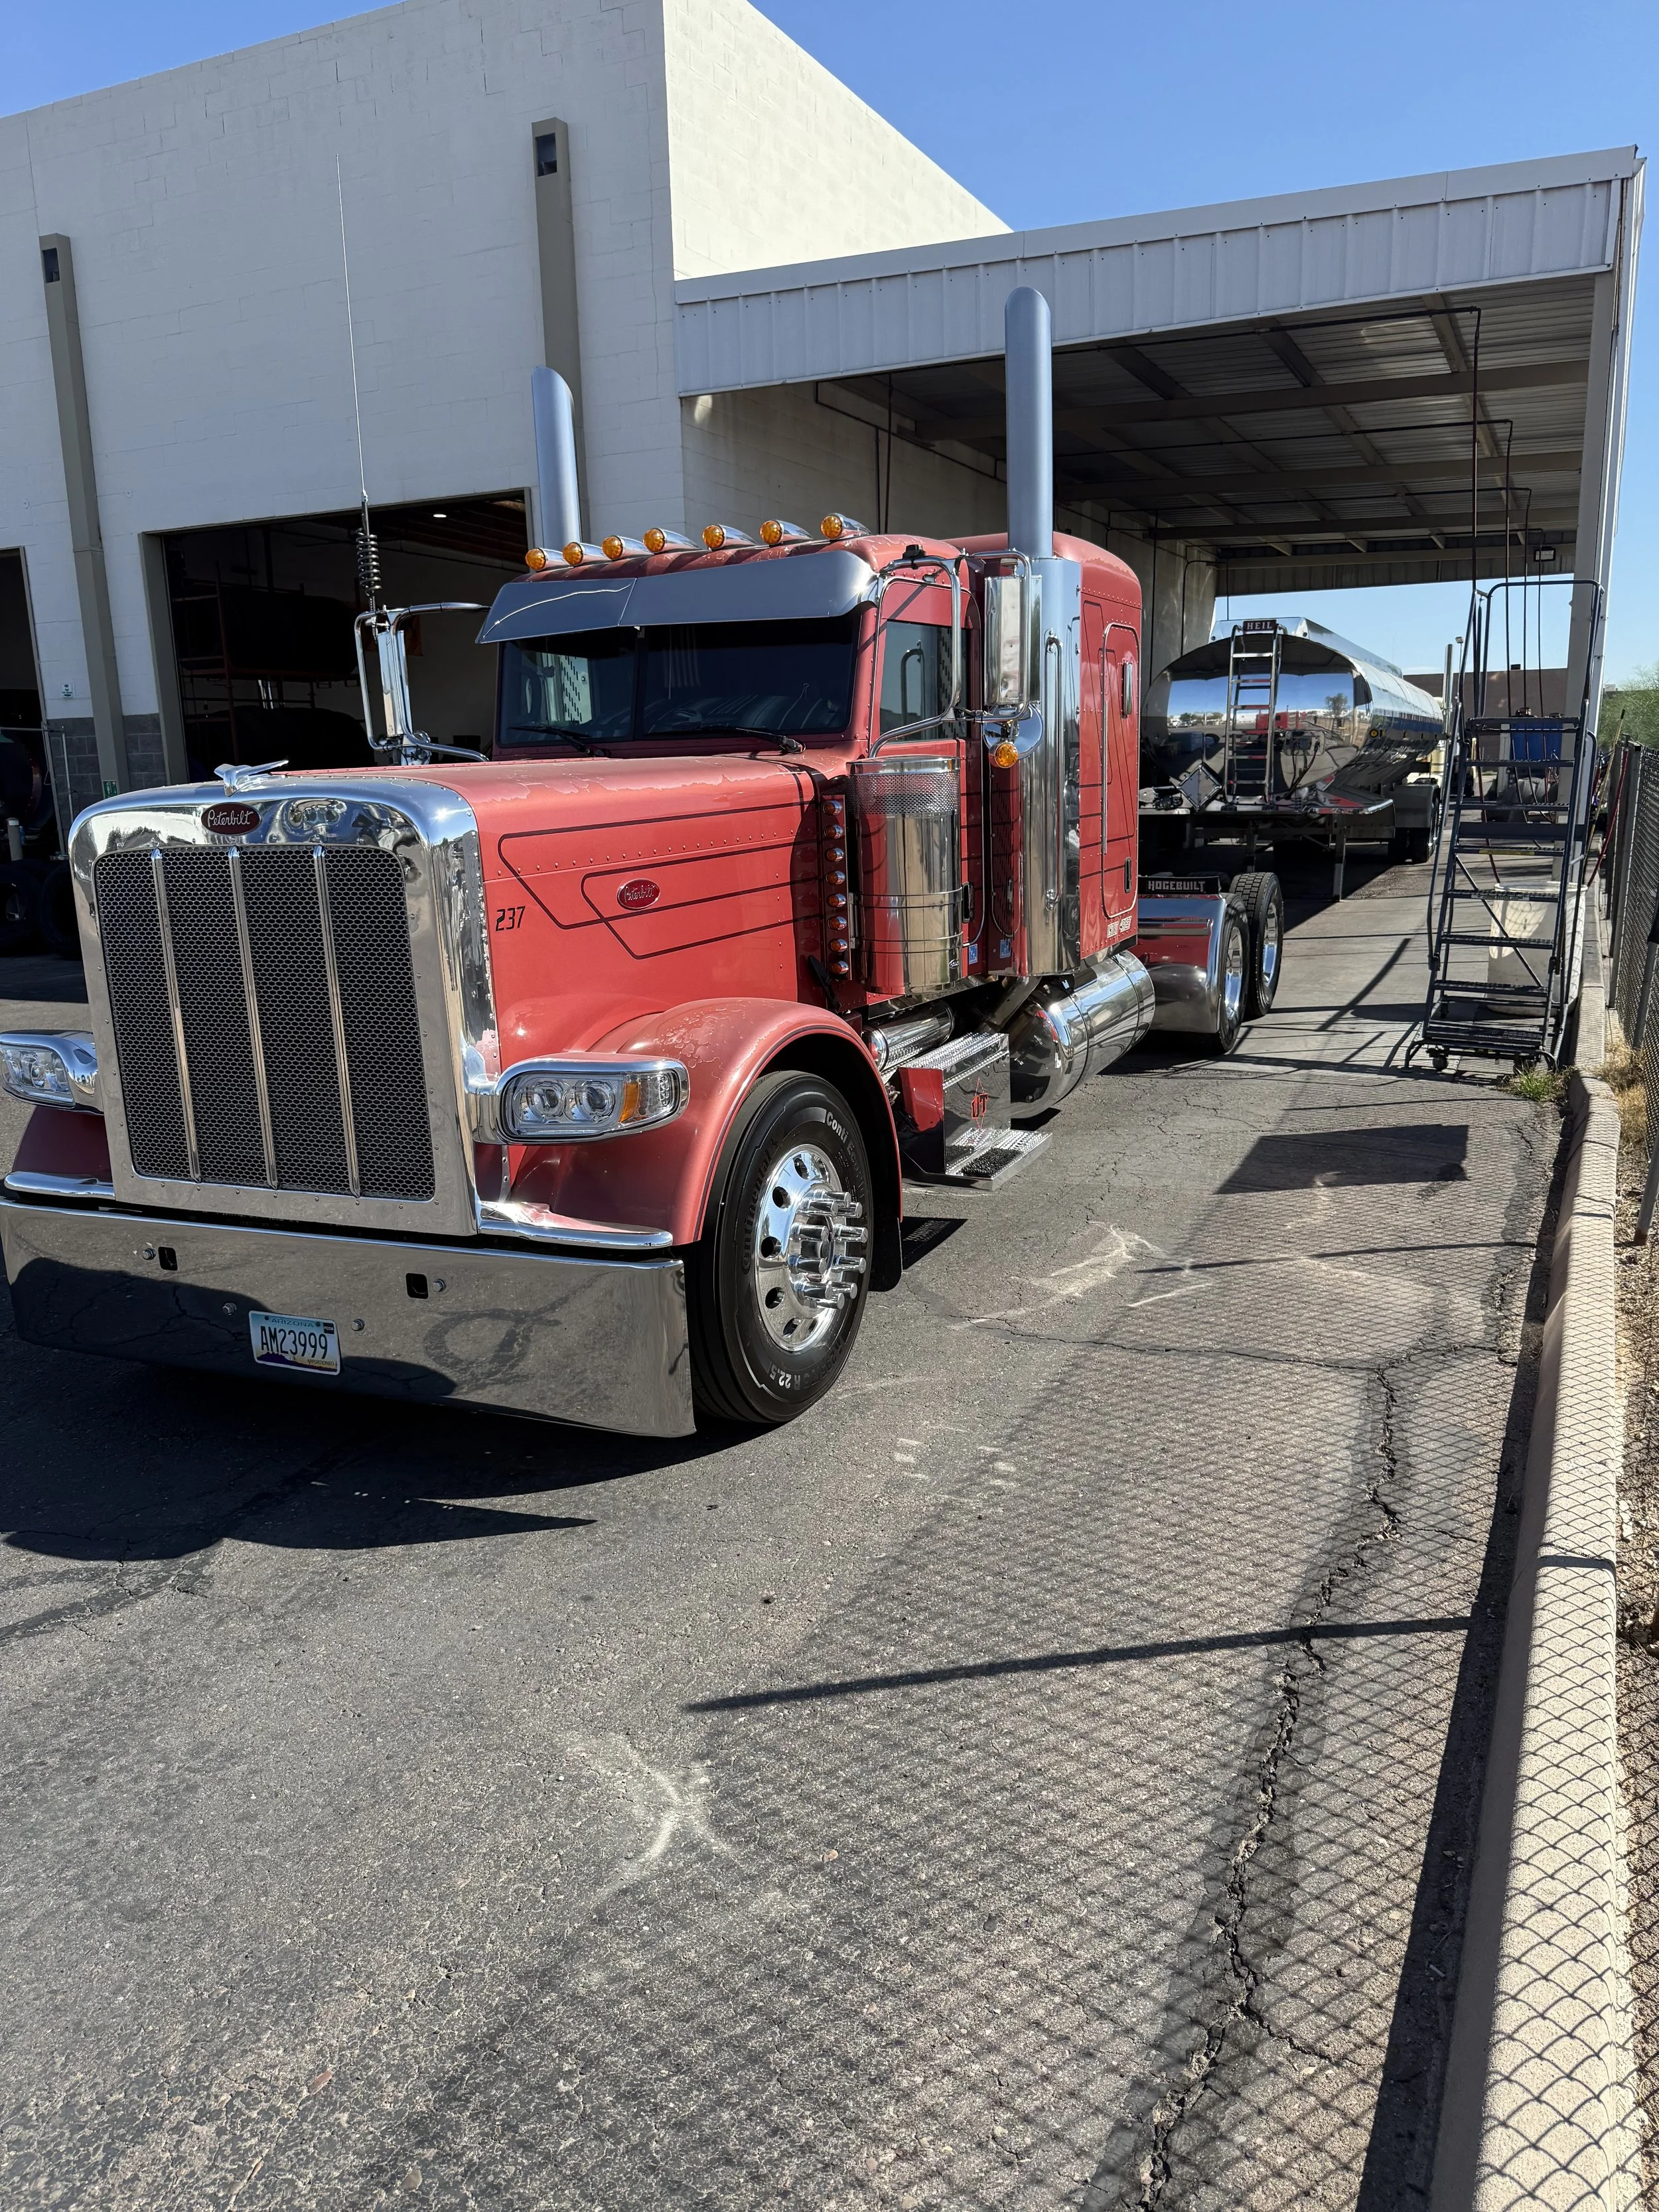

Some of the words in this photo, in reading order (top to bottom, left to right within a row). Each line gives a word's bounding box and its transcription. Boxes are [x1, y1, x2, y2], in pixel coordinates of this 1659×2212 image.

[1247, 621, 1272, 630] HEIL
[207, 809, 254, 828] Peterbilt
[1148, 880, 1206, 892] HOGEBUILT
[495, 905, 526, 932] 237
[826, 1111, 849, 1144] Conti
[271, 1317, 314, 1328] ARIZONA
[260, 1325, 328, 1360] AM23999
[769, 1364, 792, 1389] 22.5
